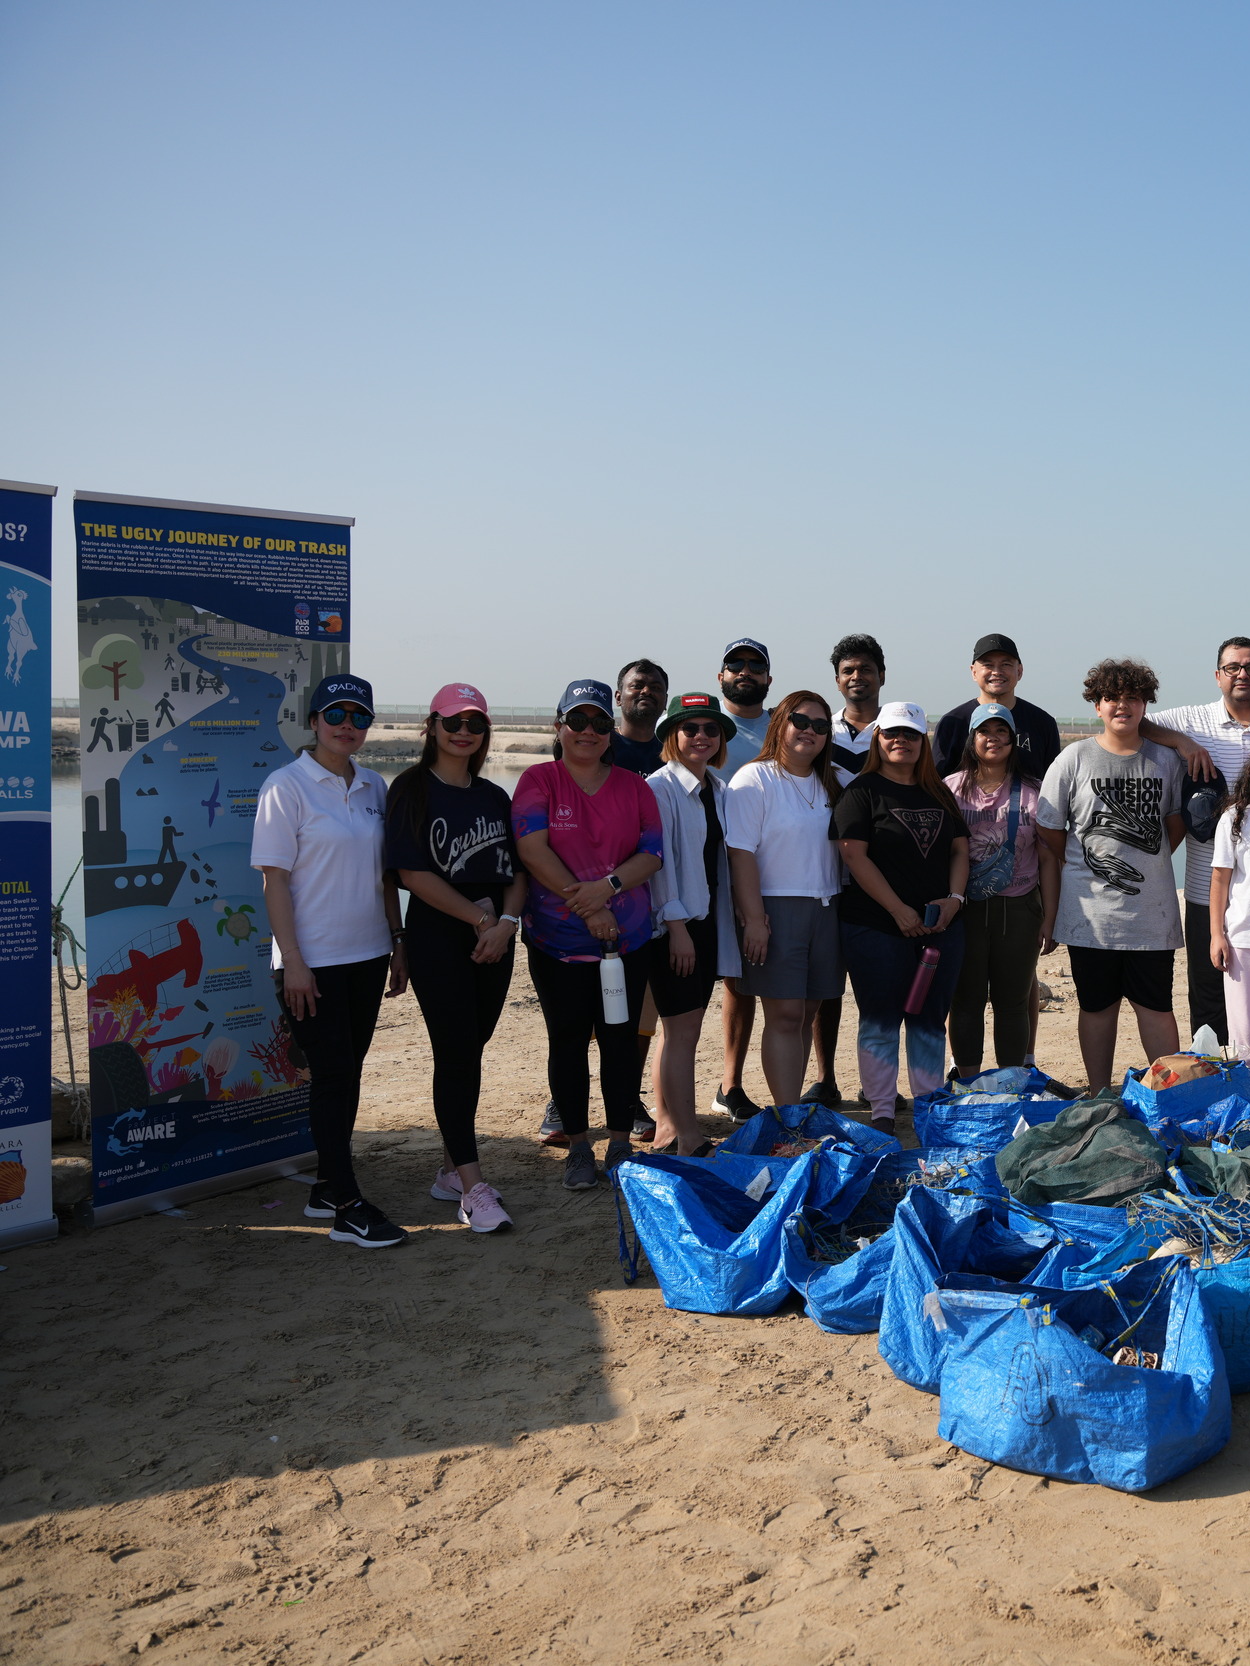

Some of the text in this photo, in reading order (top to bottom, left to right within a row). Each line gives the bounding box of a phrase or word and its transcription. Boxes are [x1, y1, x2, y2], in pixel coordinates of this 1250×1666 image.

[81, 522, 346, 556] THE UGLY JOURNEY OF OUR TRASH
[337, 683, 367, 697] ADNIC
[581, 687, 607, 701] ADNIC
[1015, 734, 1032, 752] A
[1091, 778, 1162, 792] ILLUSION
[902, 812, 940, 822] GUESS
[430, 816, 506, 872] Courtlan
[128, 1112, 175, 1128] PROJECT
[126, 1120, 175, 1142] AWARE
[98, 1167, 122, 1178] Follow
